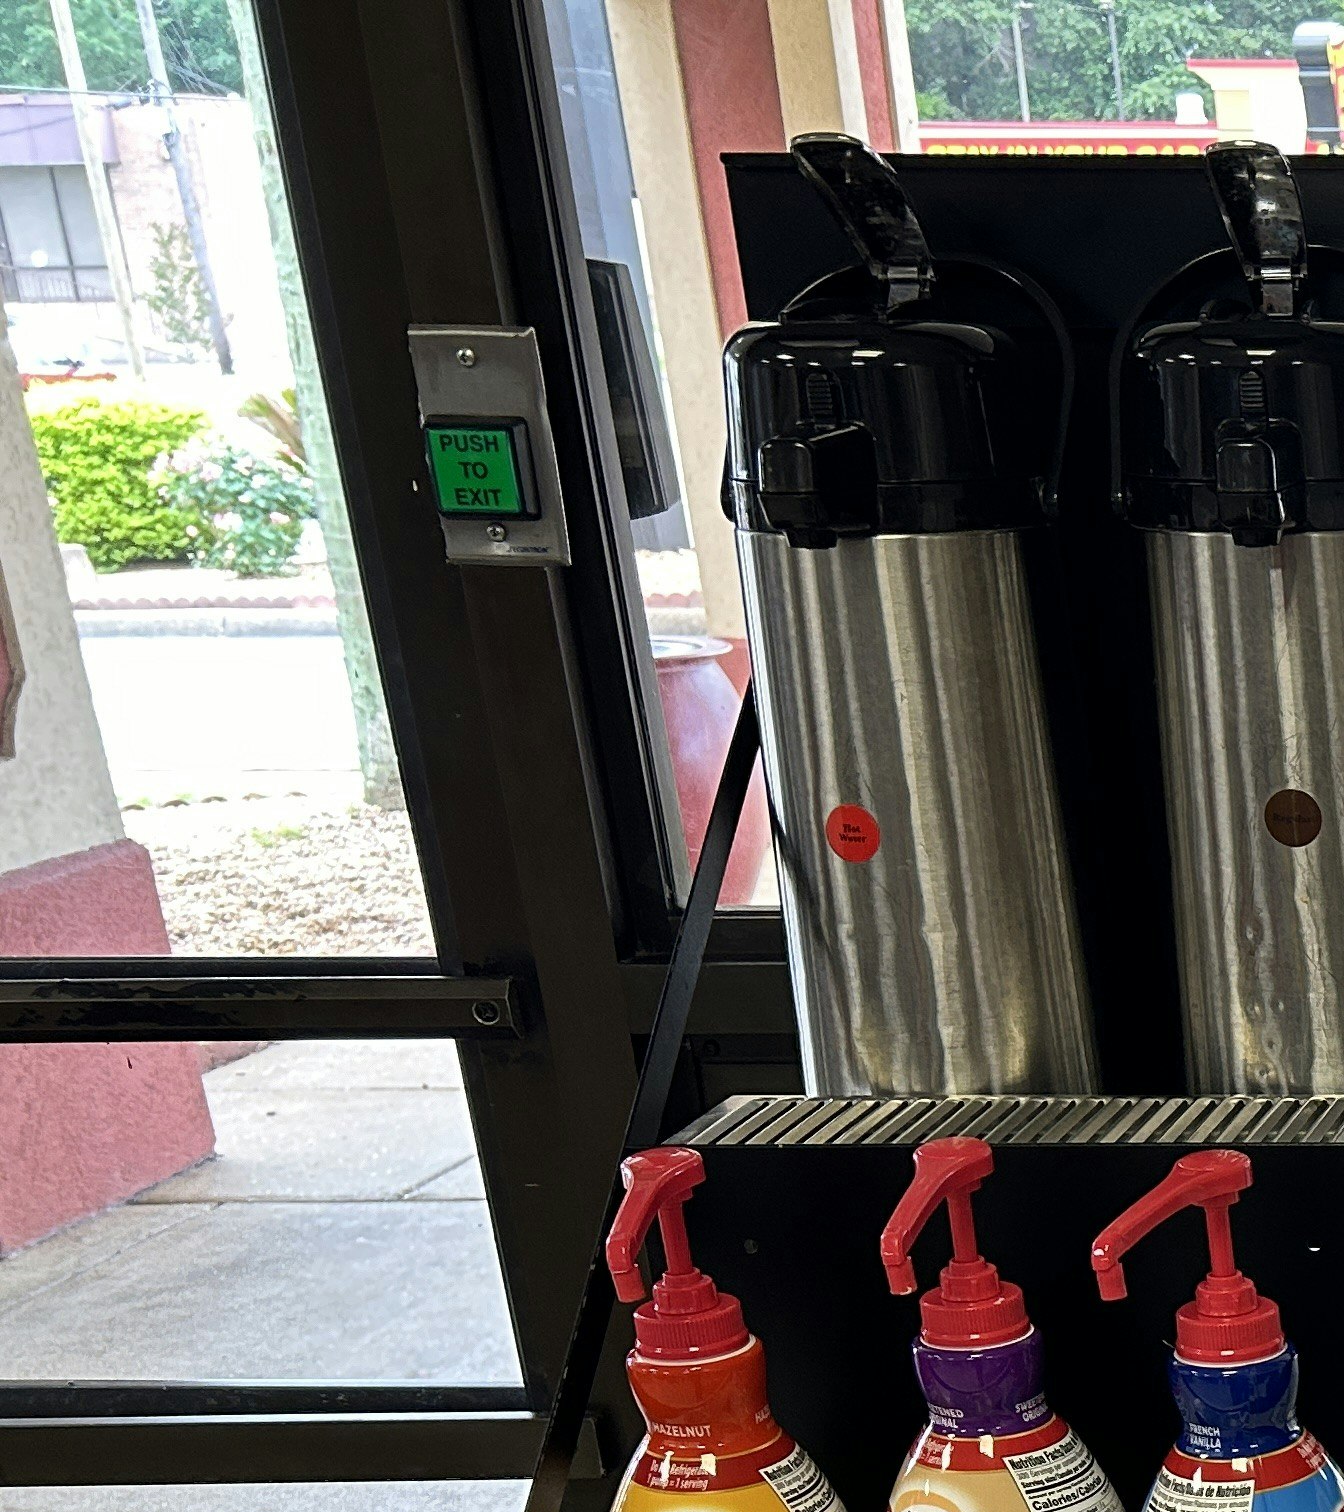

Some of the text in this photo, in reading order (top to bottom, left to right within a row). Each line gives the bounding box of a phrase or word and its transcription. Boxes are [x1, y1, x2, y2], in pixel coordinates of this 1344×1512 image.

[439, 434, 500, 453] PUSH
[458, 461, 489, 479] TO
[453, 488, 503, 506] EXIT
[842, 823, 861, 833] Hot
[839, 833, 867, 843] Water
[651, 1422, 712, 1438] HAZELNUT
[1189, 1423, 1221, 1436] FRENCH
[1189, 1435, 1222, 1449] VANILLA
